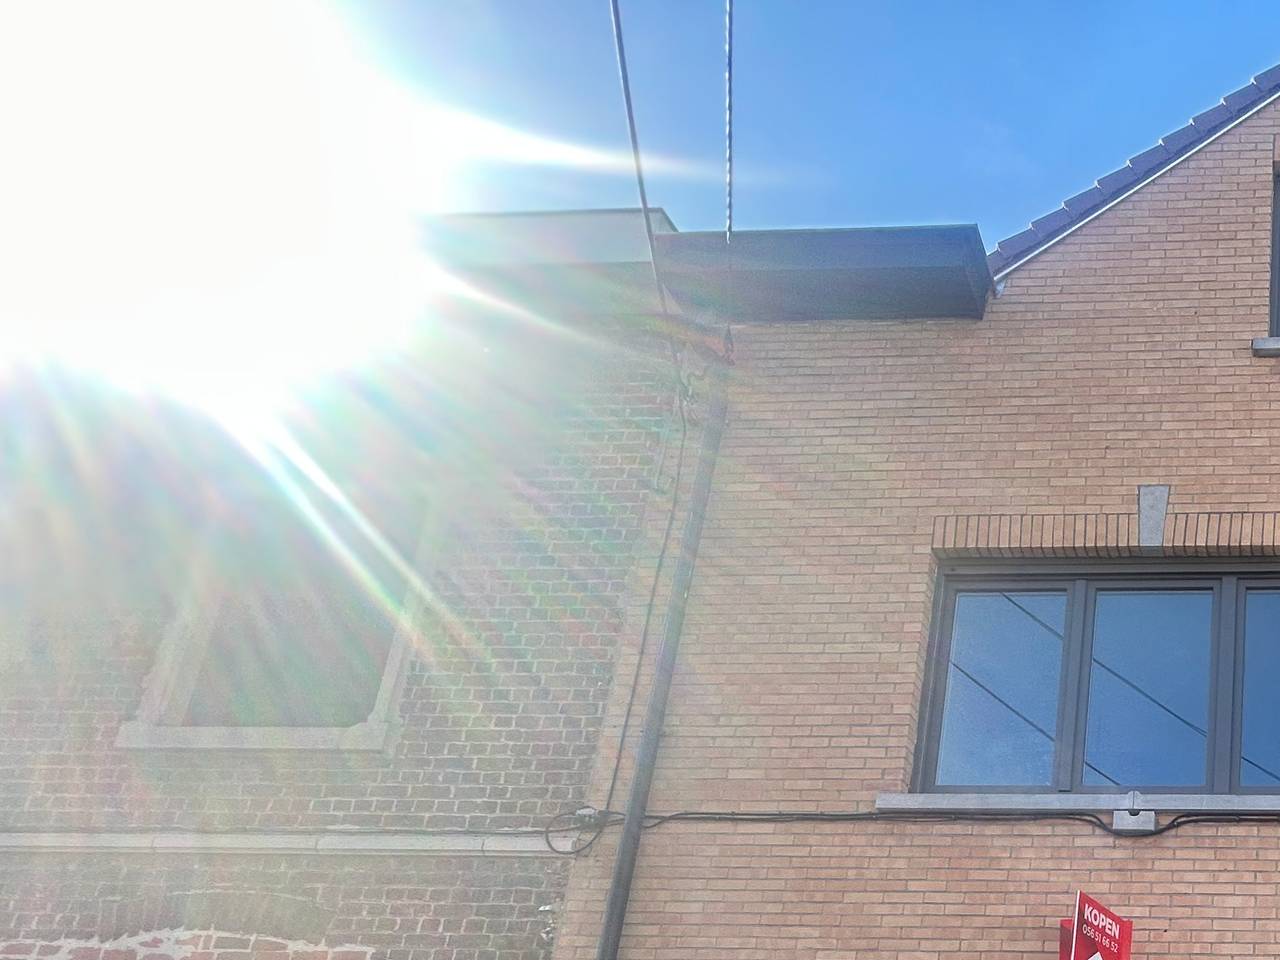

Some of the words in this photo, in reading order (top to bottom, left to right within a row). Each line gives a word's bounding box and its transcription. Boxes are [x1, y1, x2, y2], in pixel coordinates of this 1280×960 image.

[1084, 903, 1120, 940] KOPEN
[1082, 924, 1095, 939] 056
[1094, 931, 1102, 943] 51
[1110, 941, 1119, 953] 52
